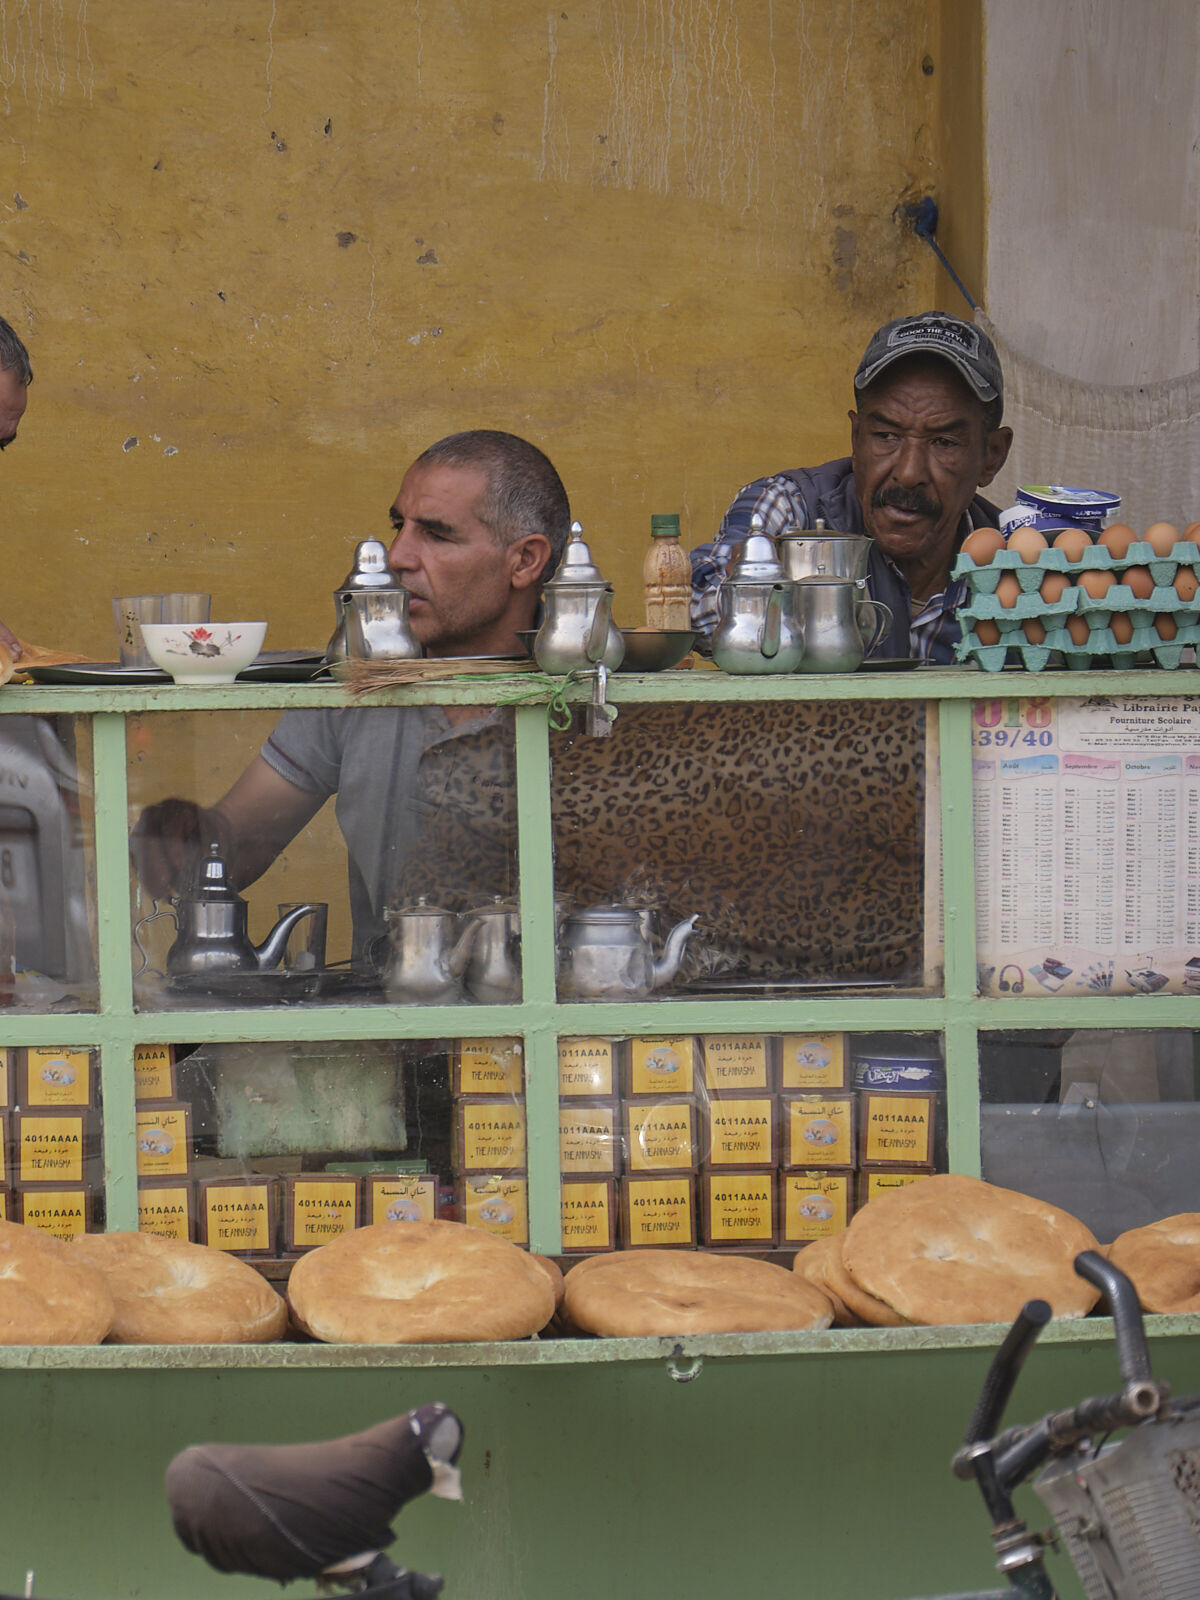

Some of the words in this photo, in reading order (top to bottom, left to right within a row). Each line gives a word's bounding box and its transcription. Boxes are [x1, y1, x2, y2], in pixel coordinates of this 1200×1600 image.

[1123, 703, 1178, 712] Librairie
[1110, 716, 1155, 724] Fourniture
[1157, 716, 1192, 724] Scolaire
[709, 1042, 762, 1050] 4011AAAA
[827, 1106, 844, 1118] شاي
[161, 1116, 178, 1127] شاي
[715, 1117, 768, 1125] 4011AAAA
[872, 1114, 925, 1122] 4011AAAA
[468, 1122, 521, 1131] 4011AAAA
[25, 1135, 78, 1143] 4011AAAA
[410, 1186, 426, 1199] شاي
[503, 1185, 519, 1197] شاي
[823, 1182, 840, 1194] شاي
[634, 1197, 686, 1206] 4011AAAA
[715, 1194, 768, 1202] 4011AAAA
[211, 1204, 264, 1212] 4011AAAA
[299, 1200, 352, 1208] 4011AAAA
[561, 1200, 604, 1209] 11AAAA
[28, 1209, 81, 1217] 4011AAAA
[138, 1206, 184, 1215] 011AAAA
